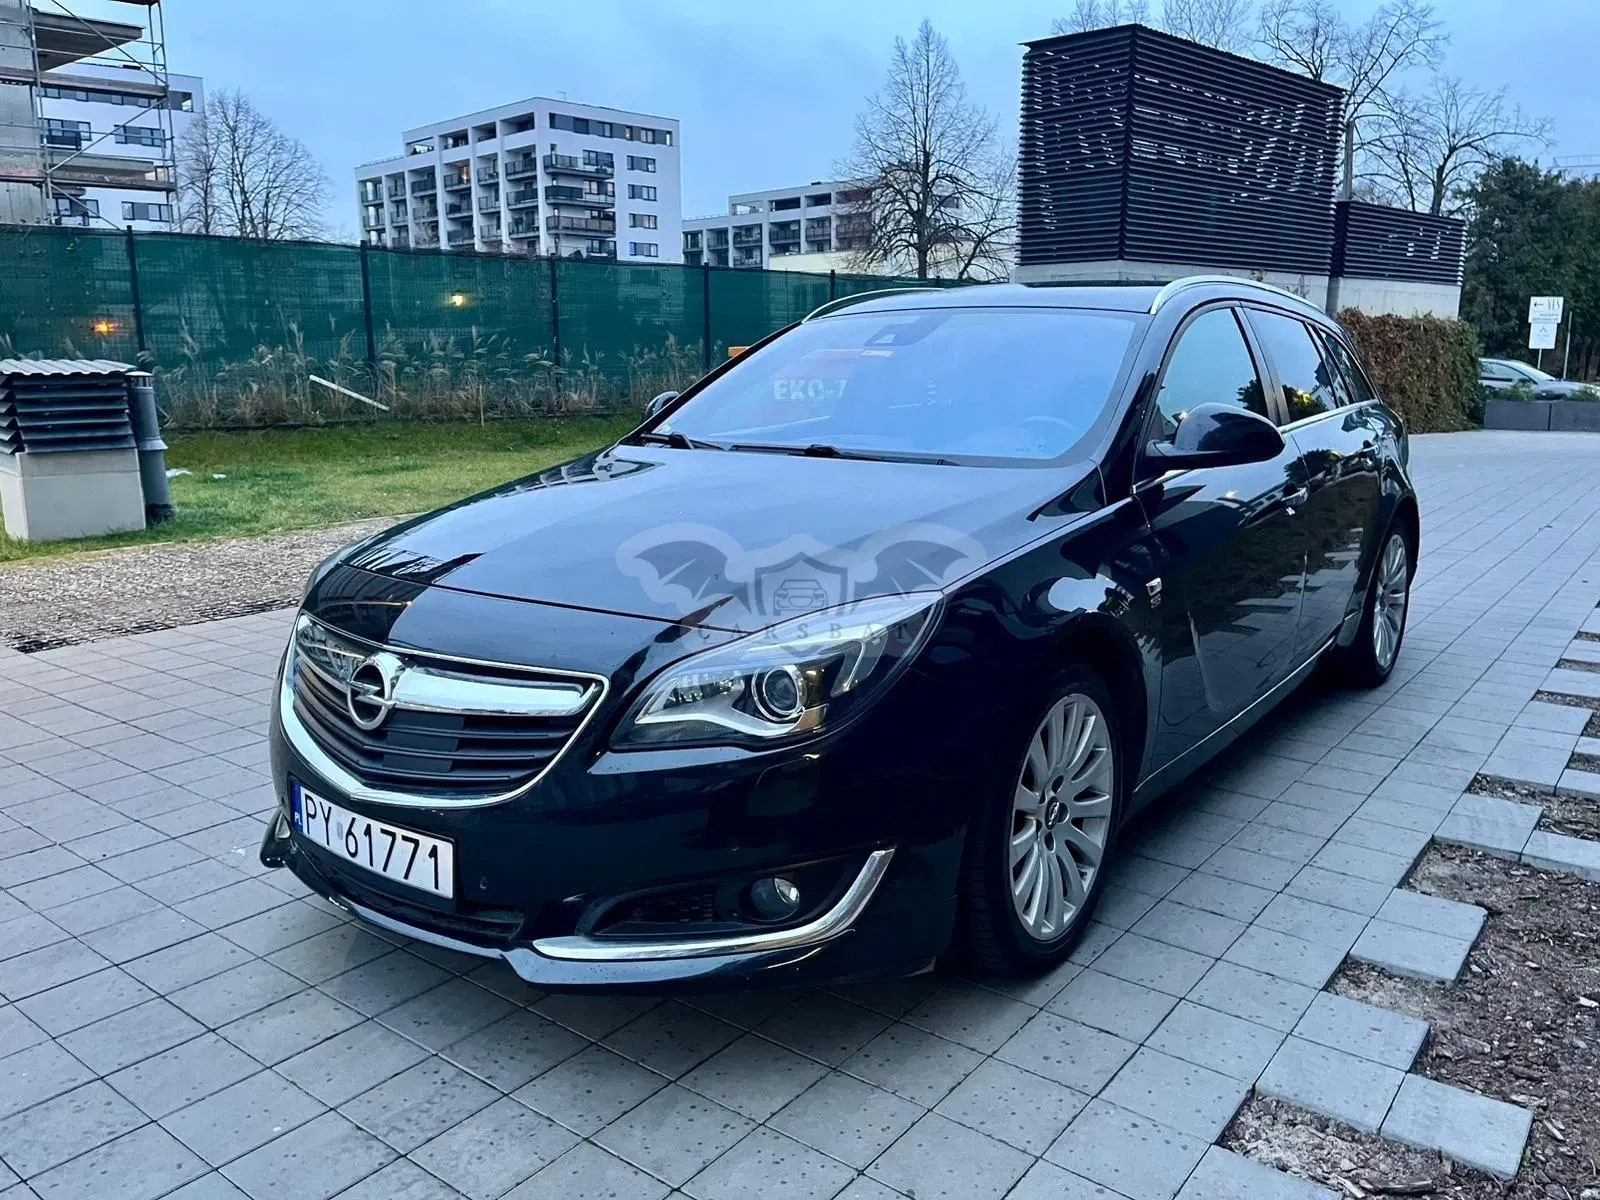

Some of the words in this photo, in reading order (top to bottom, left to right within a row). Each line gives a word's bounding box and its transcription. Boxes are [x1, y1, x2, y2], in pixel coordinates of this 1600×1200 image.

[294, 811, 303, 825] PL
[304, 793, 333, 847] PY
[344, 816, 440, 891] 61771
